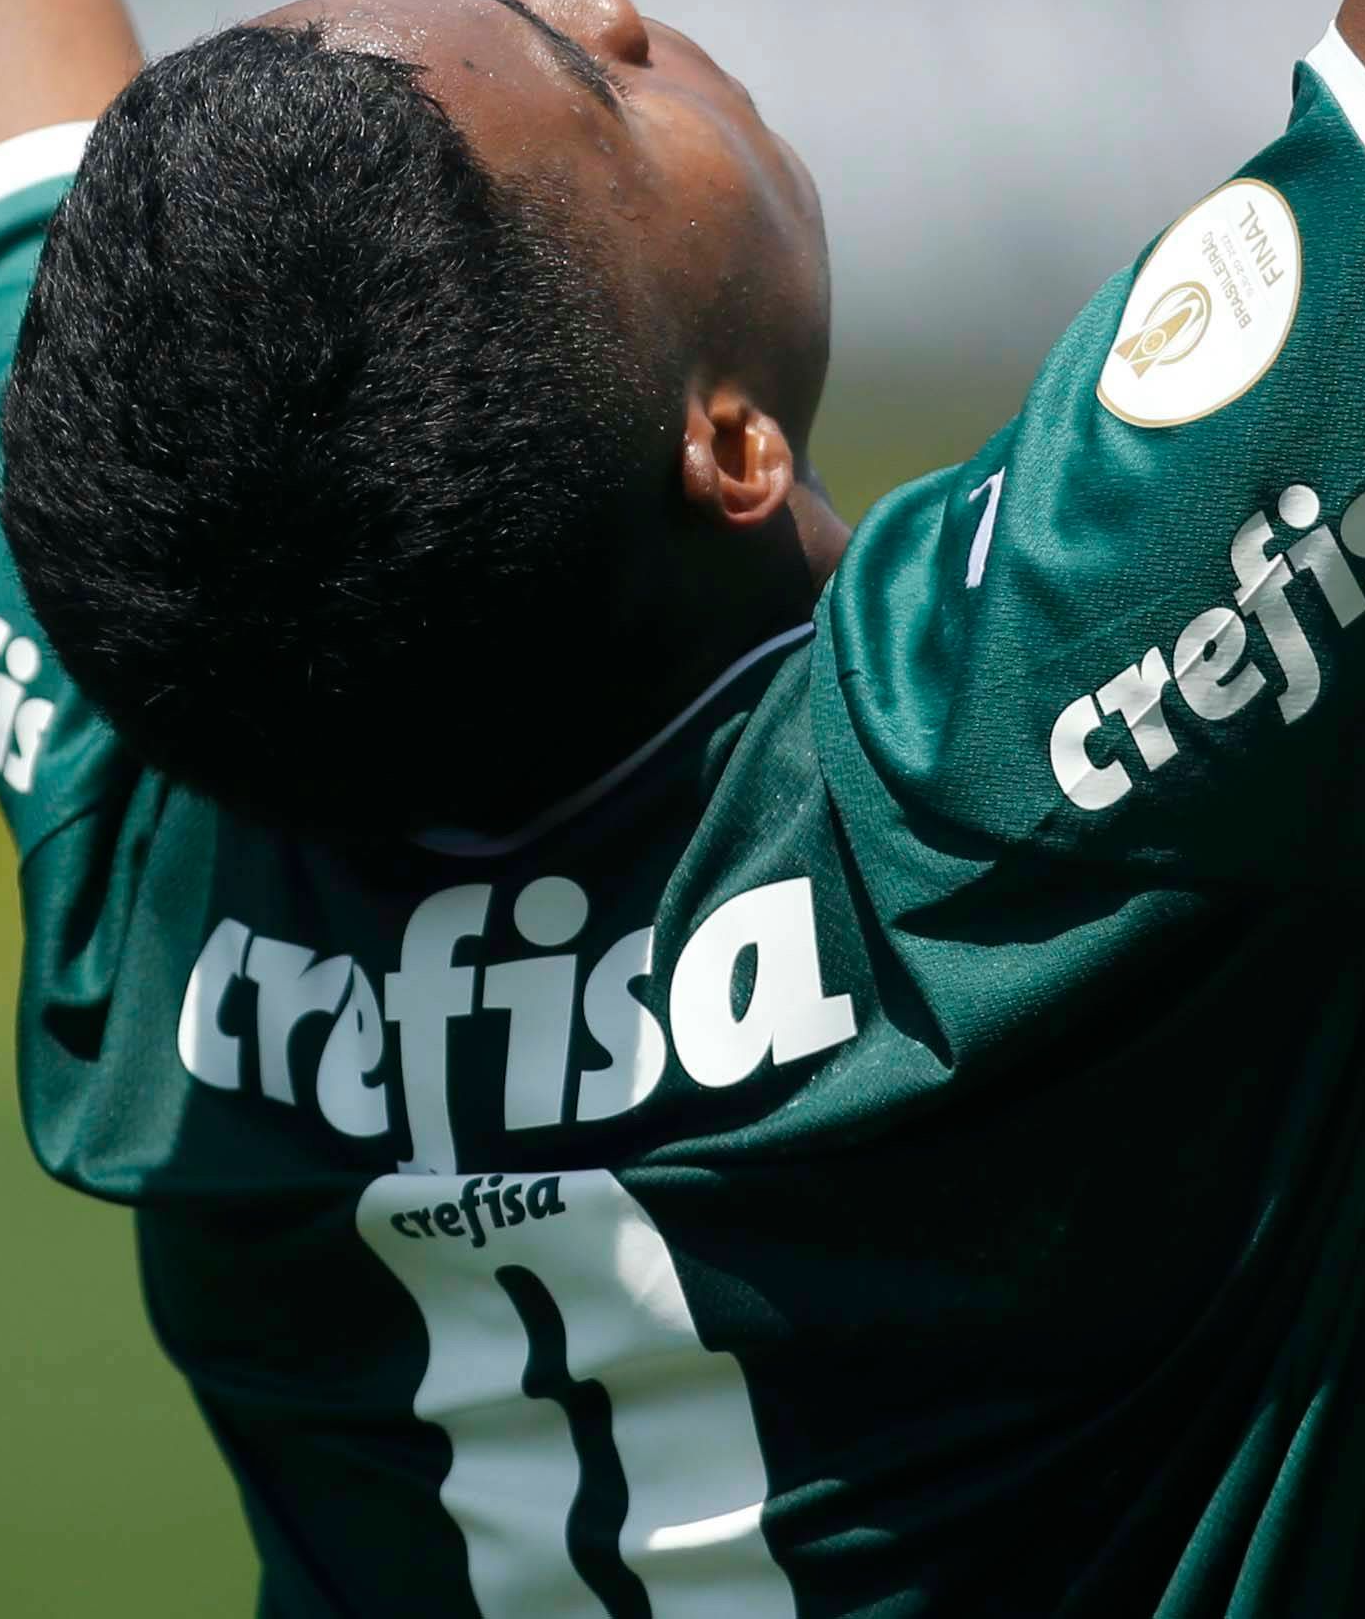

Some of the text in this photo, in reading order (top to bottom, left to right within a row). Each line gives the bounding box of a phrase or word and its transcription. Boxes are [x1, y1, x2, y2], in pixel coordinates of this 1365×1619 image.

[1238, 200, 1285, 288] FINAL
[177, 876, 858, 1176] crefisa
[390, 1174, 566, 1248] crefisa
